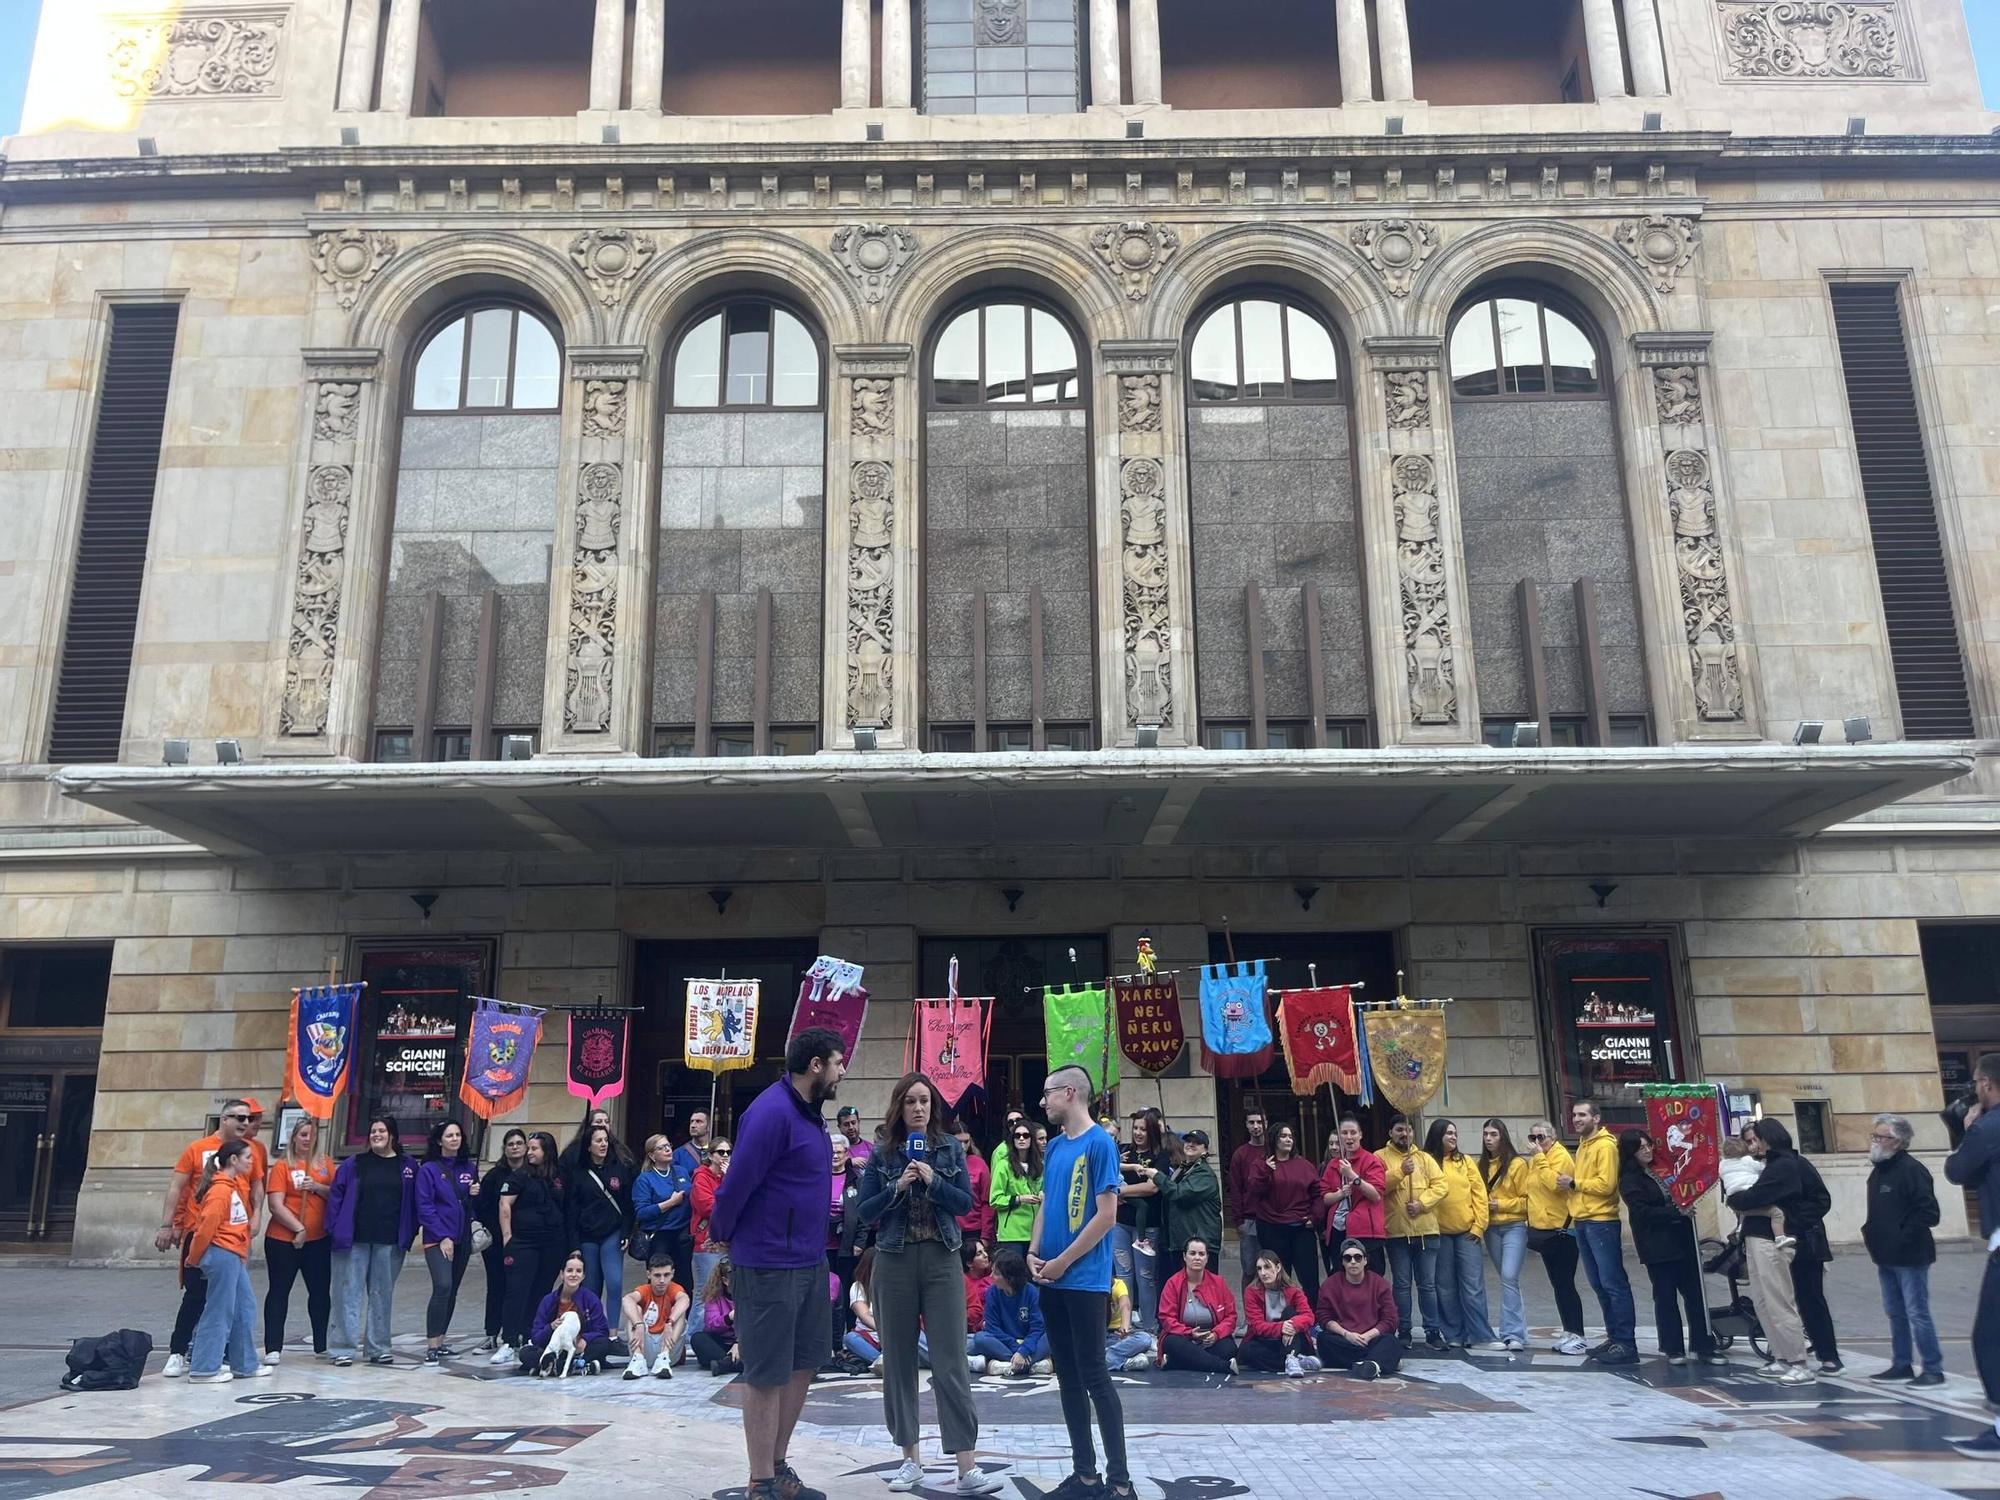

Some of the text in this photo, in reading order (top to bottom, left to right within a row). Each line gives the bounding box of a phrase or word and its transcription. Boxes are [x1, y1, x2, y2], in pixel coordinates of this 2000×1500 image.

[694, 985, 709, 996] LOS
[1121, 988, 1172, 1002] XAREU
[1134, 1005, 1164, 1018] NEL
[582, 1027, 615, 1039] CHARANGA
[1127, 1019, 1173, 1035] ÑERU
[1141, 1038, 1179, 1053] XOVE
[1604, 1037, 1650, 1048] GIANNI
[401, 1048, 447, 1060] GIANNI
[1591, 1049, 1651, 1060] SCHICCHI
[385, 1060, 445, 1072] SCHICCHI
[1071, 1163, 1086, 1218] XAREU
